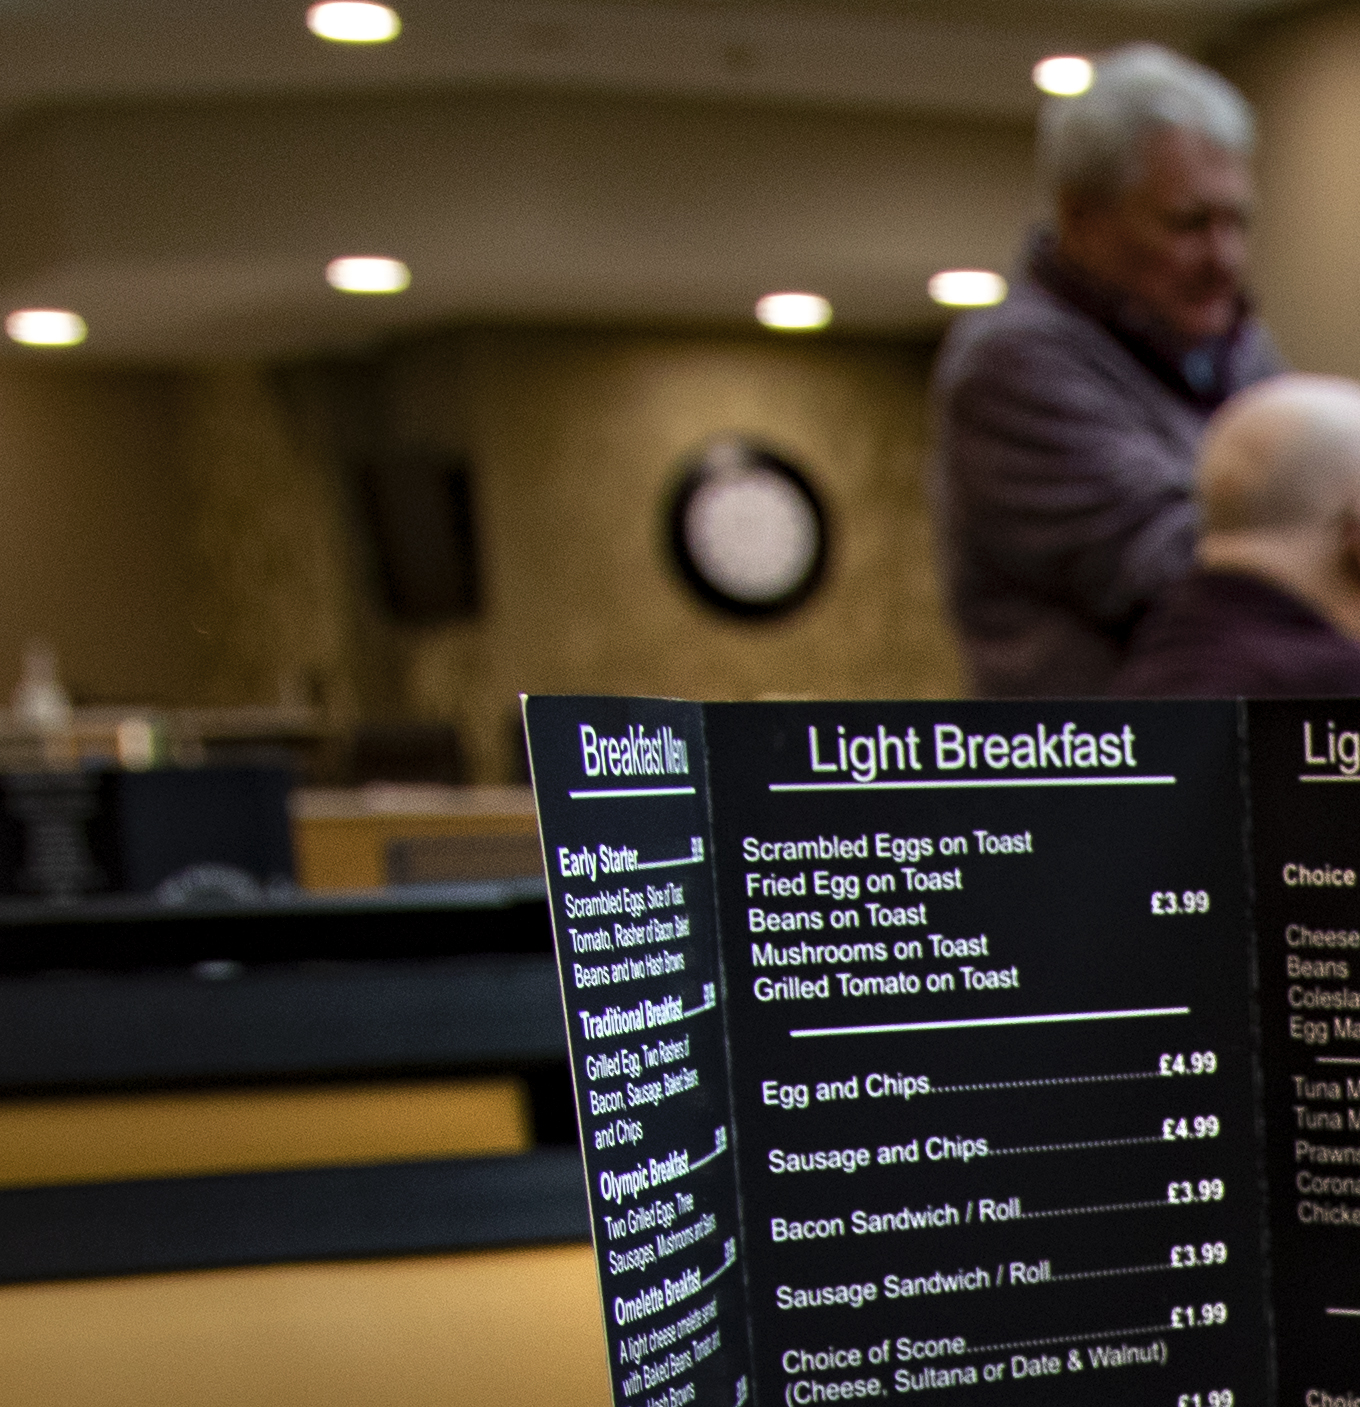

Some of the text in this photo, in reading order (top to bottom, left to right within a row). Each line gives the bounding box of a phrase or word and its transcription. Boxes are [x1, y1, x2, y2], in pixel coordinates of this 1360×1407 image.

[579, 723, 665, 777] Breakfast
[807, 721, 1137, 782] Light Breakfast
[741, 829, 1033, 862] Scrambled Eggs on Toast
[557, 844, 639, 882] Early Starter
[1282, 862, 1357, 887] Choice
[744, 867, 963, 900] Fried Egg on Toast
[565, 889, 622, 919] Scrambled
[747, 902, 928, 933] Beans on Toast
[1150, 889, 1210, 915] £3.99
[614, 921, 646, 948] Rasher
[750, 933, 989, 967] Mushrooms on Toast
[573, 957, 629, 988] Beans and
[1286, 954, 1350, 979] Beans
[752, 965, 1020, 1002] Grilled Tomato on Toast
[578, 995, 684, 1040] Traditional Breakfast
[1289, 1015, 1329, 1044] Egg
[586, 1052, 621, 1081] Grilled
[761, 1050, 1218, 1110] Egg and Chips £4.99
[1292, 1075, 1342, 1099] Tuna
[594, 1118, 644, 1150] and Chips
[1293, 1105, 1343, 1130] Tuna
[767, 1114, 1221, 1174] Sausage and Chips £4.99
[600, 1163, 649, 1205] Olympic
[769, 1177, 1225, 1243] Bacon Sandwich Roll £3.99
[775, 1241, 1228, 1310] Sausage Sandwich Roll £3.99
[615, 1285, 664, 1326] Omelette
[781, 1301, 1228, 1374] Choice of Scone £1.99
[894, 1366, 979, 1393] Sultana
[982, 1362, 1006, 1383] or
[1010, 1355, 1062, 1380] Date
[1066, 1349, 1084, 1372] &
[1087, 1341, 1168, 1369] Walnut)
